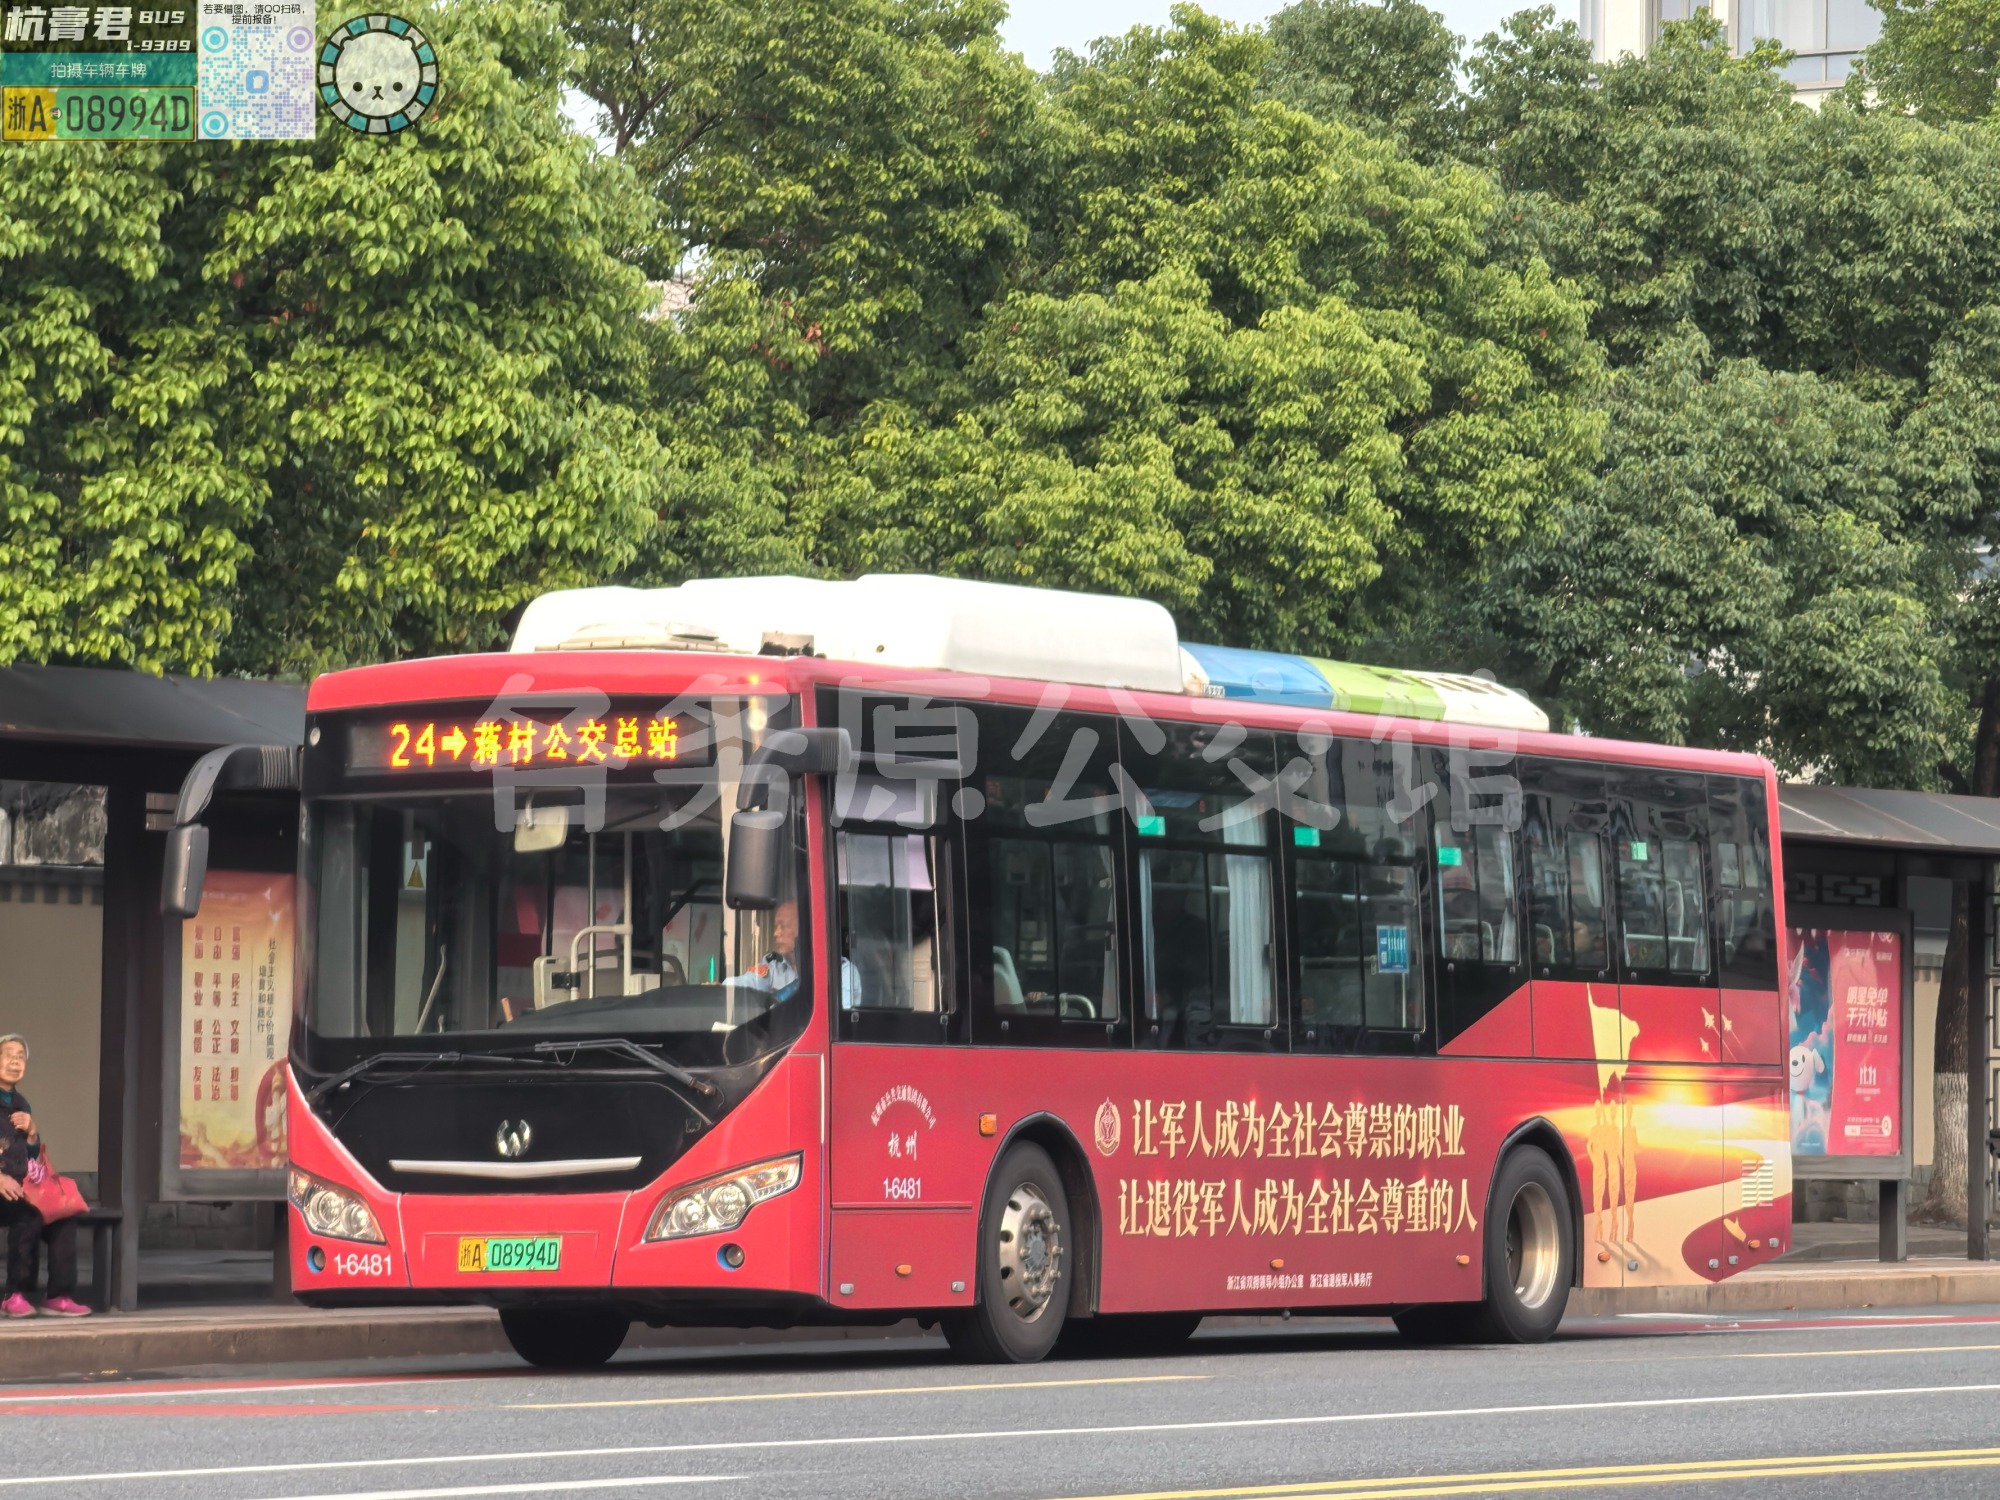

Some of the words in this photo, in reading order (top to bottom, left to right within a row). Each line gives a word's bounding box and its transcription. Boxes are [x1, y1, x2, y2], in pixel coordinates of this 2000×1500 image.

[391, 724, 436, 767] 24
[472, 716, 678, 764] 蒋村公交总站
[1846, 1007, 1888, 1028] 千元补贴
[1132, 1098, 1465, 1160] 让军人成为全社会尊崇的职业
[888, 1130, 917, 1161] 杭州
[883, 1177, 921, 1199] 1-6481
[1118, 1177, 1478, 1238] 让退役军人成为全社会尊重的人
[333, 1253, 392, 1276] 1-6481
